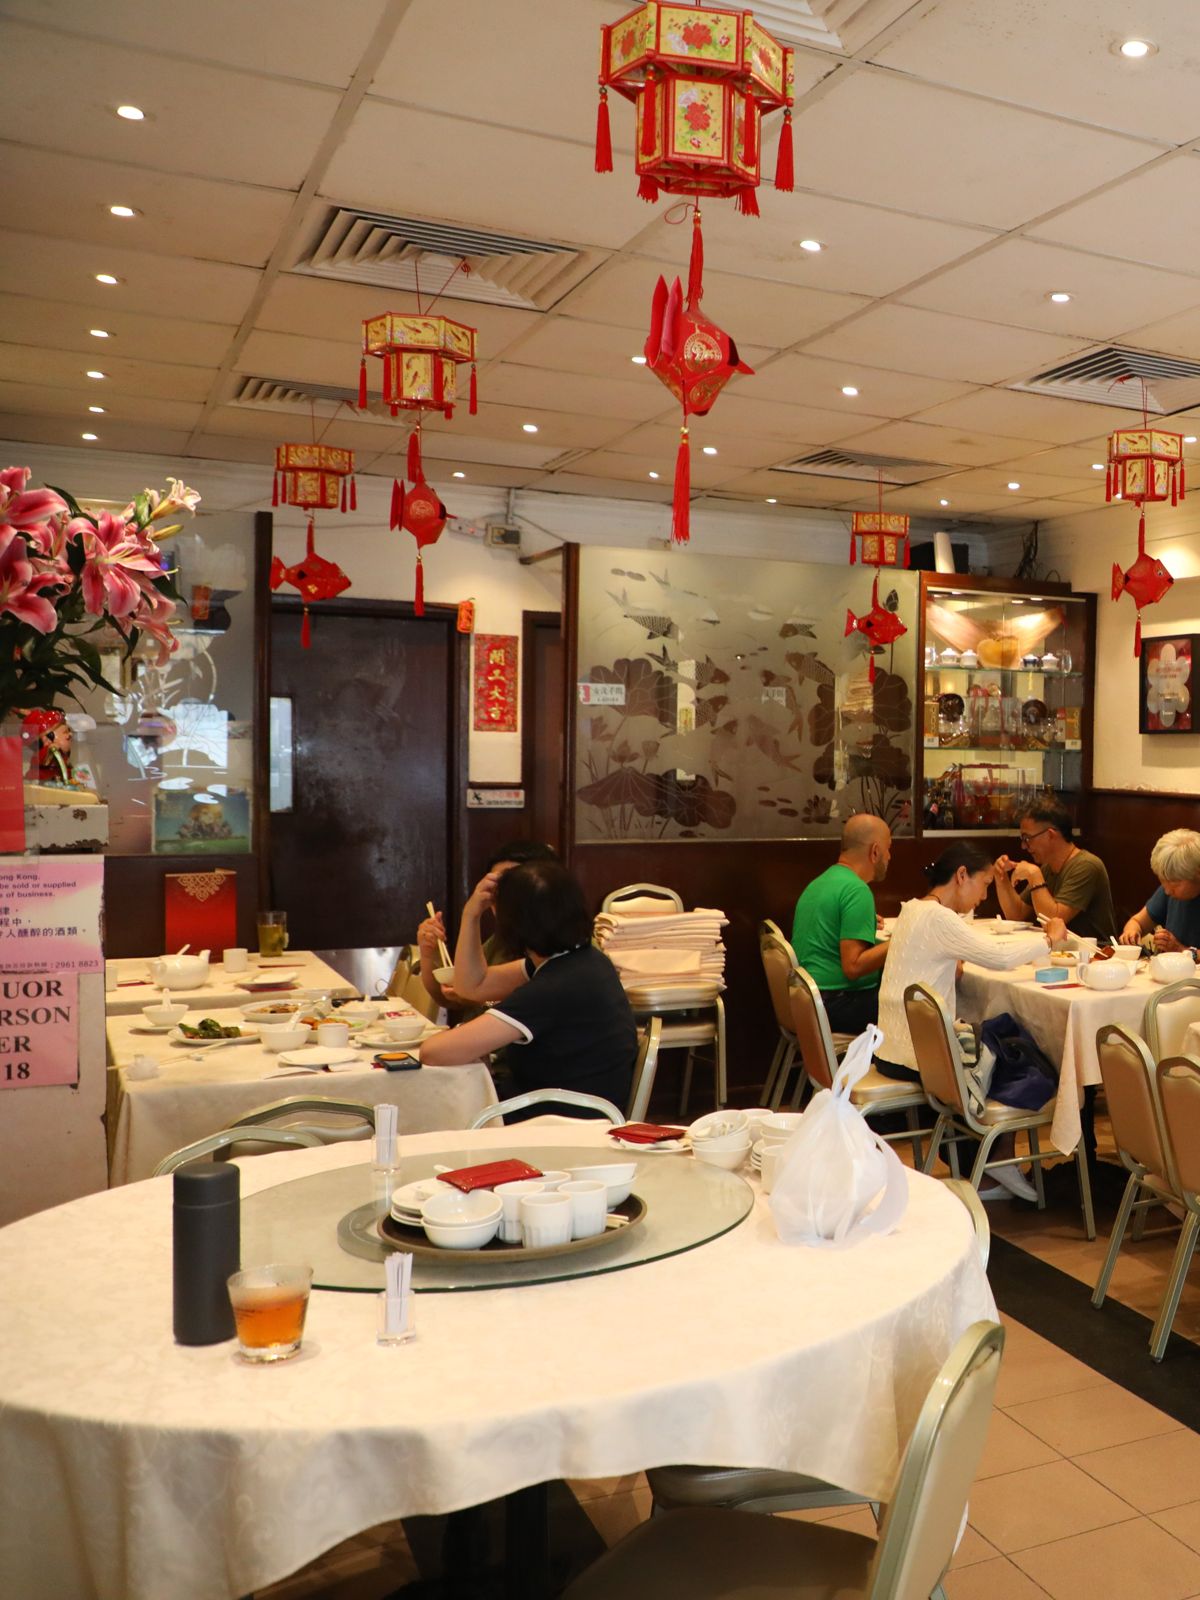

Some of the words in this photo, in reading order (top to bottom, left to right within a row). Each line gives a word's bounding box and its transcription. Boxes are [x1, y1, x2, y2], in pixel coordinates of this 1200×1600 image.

[16, 874, 40, 882] Kong.
[43, 881, 76, 890] supplied
[17, 890, 55, 898] business.
[55, 961, 75, 969] 2961
[79, 960, 99, 968] 8823
[5, 1062, 31, 1080] 18
